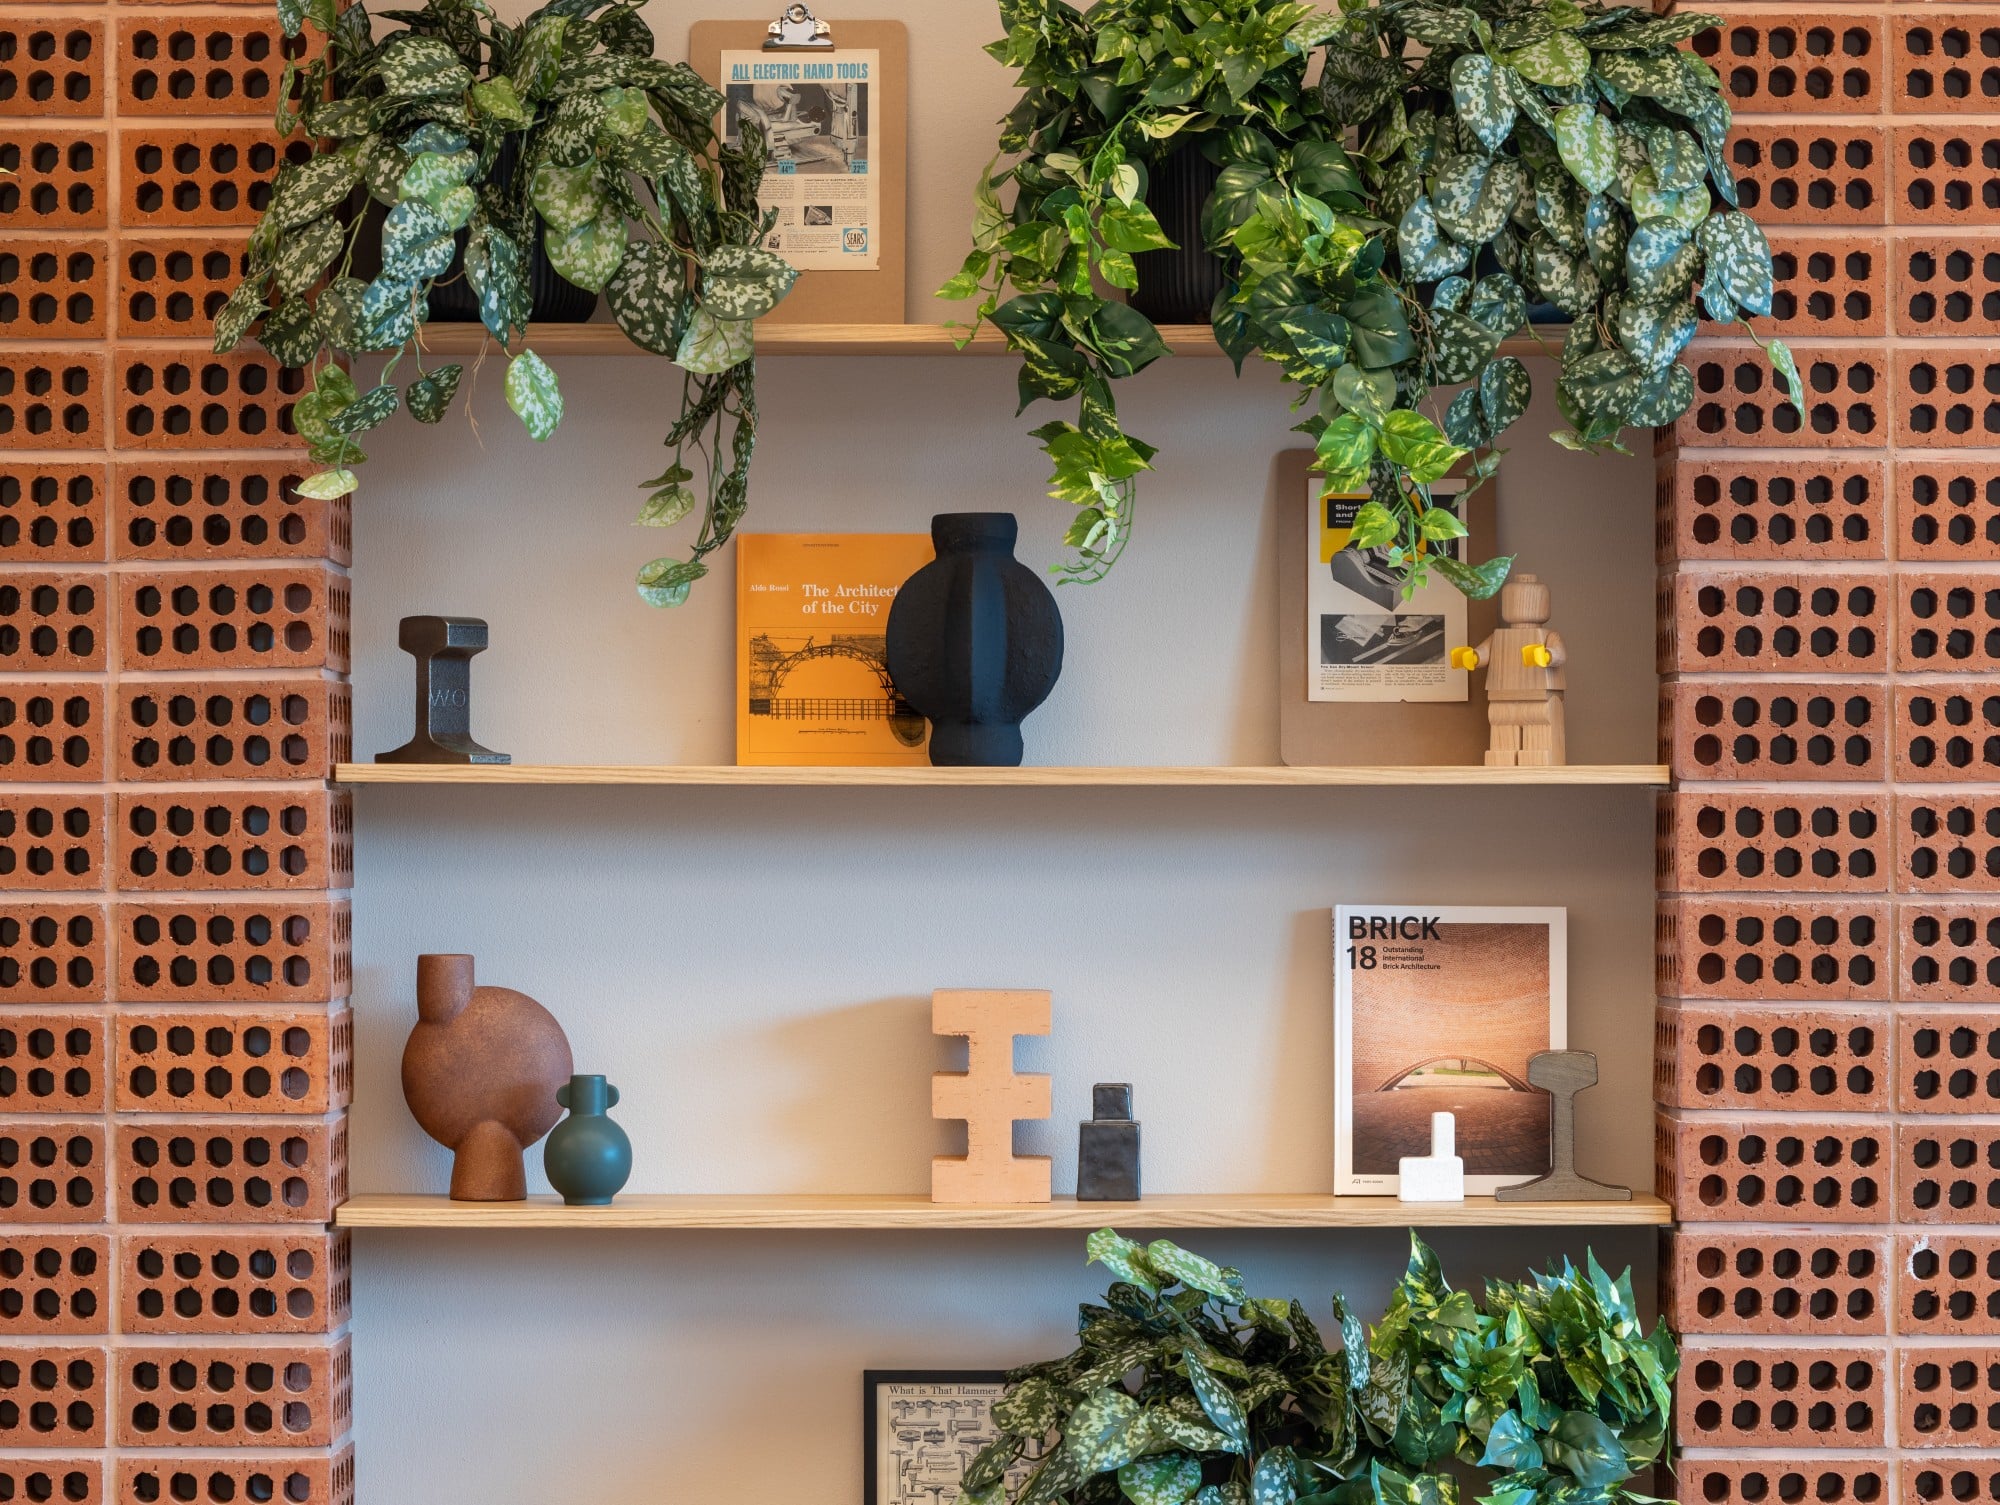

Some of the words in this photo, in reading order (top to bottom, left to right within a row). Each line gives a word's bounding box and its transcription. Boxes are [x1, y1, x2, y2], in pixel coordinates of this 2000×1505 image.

[732, 63, 750, 80] ALL
[753, 63, 800, 80] ELECTRIC
[803, 63, 834, 80] HAND
[837, 63, 868, 80] TOOLS
[846, 233, 865, 245] SEARS
[750, 584, 767, 592] Aldo
[802, 584, 829, 597] The
[835, 584, 899, 597] Architect
[802, 601, 817, 614] of
[822, 601, 844, 614] the
[849, 601, 879, 616] City
[1349, 916, 1441, 940] BRICK
[1382, 946, 1424, 954] Outstanding
[1346, 945, 1377, 970] 18
[888, 1385, 914, 1395] What
[919, 1386, 927, 1395] is
[930, 1385, 952, 1395] That
[957, 1386, 998, 1395] Hammer
